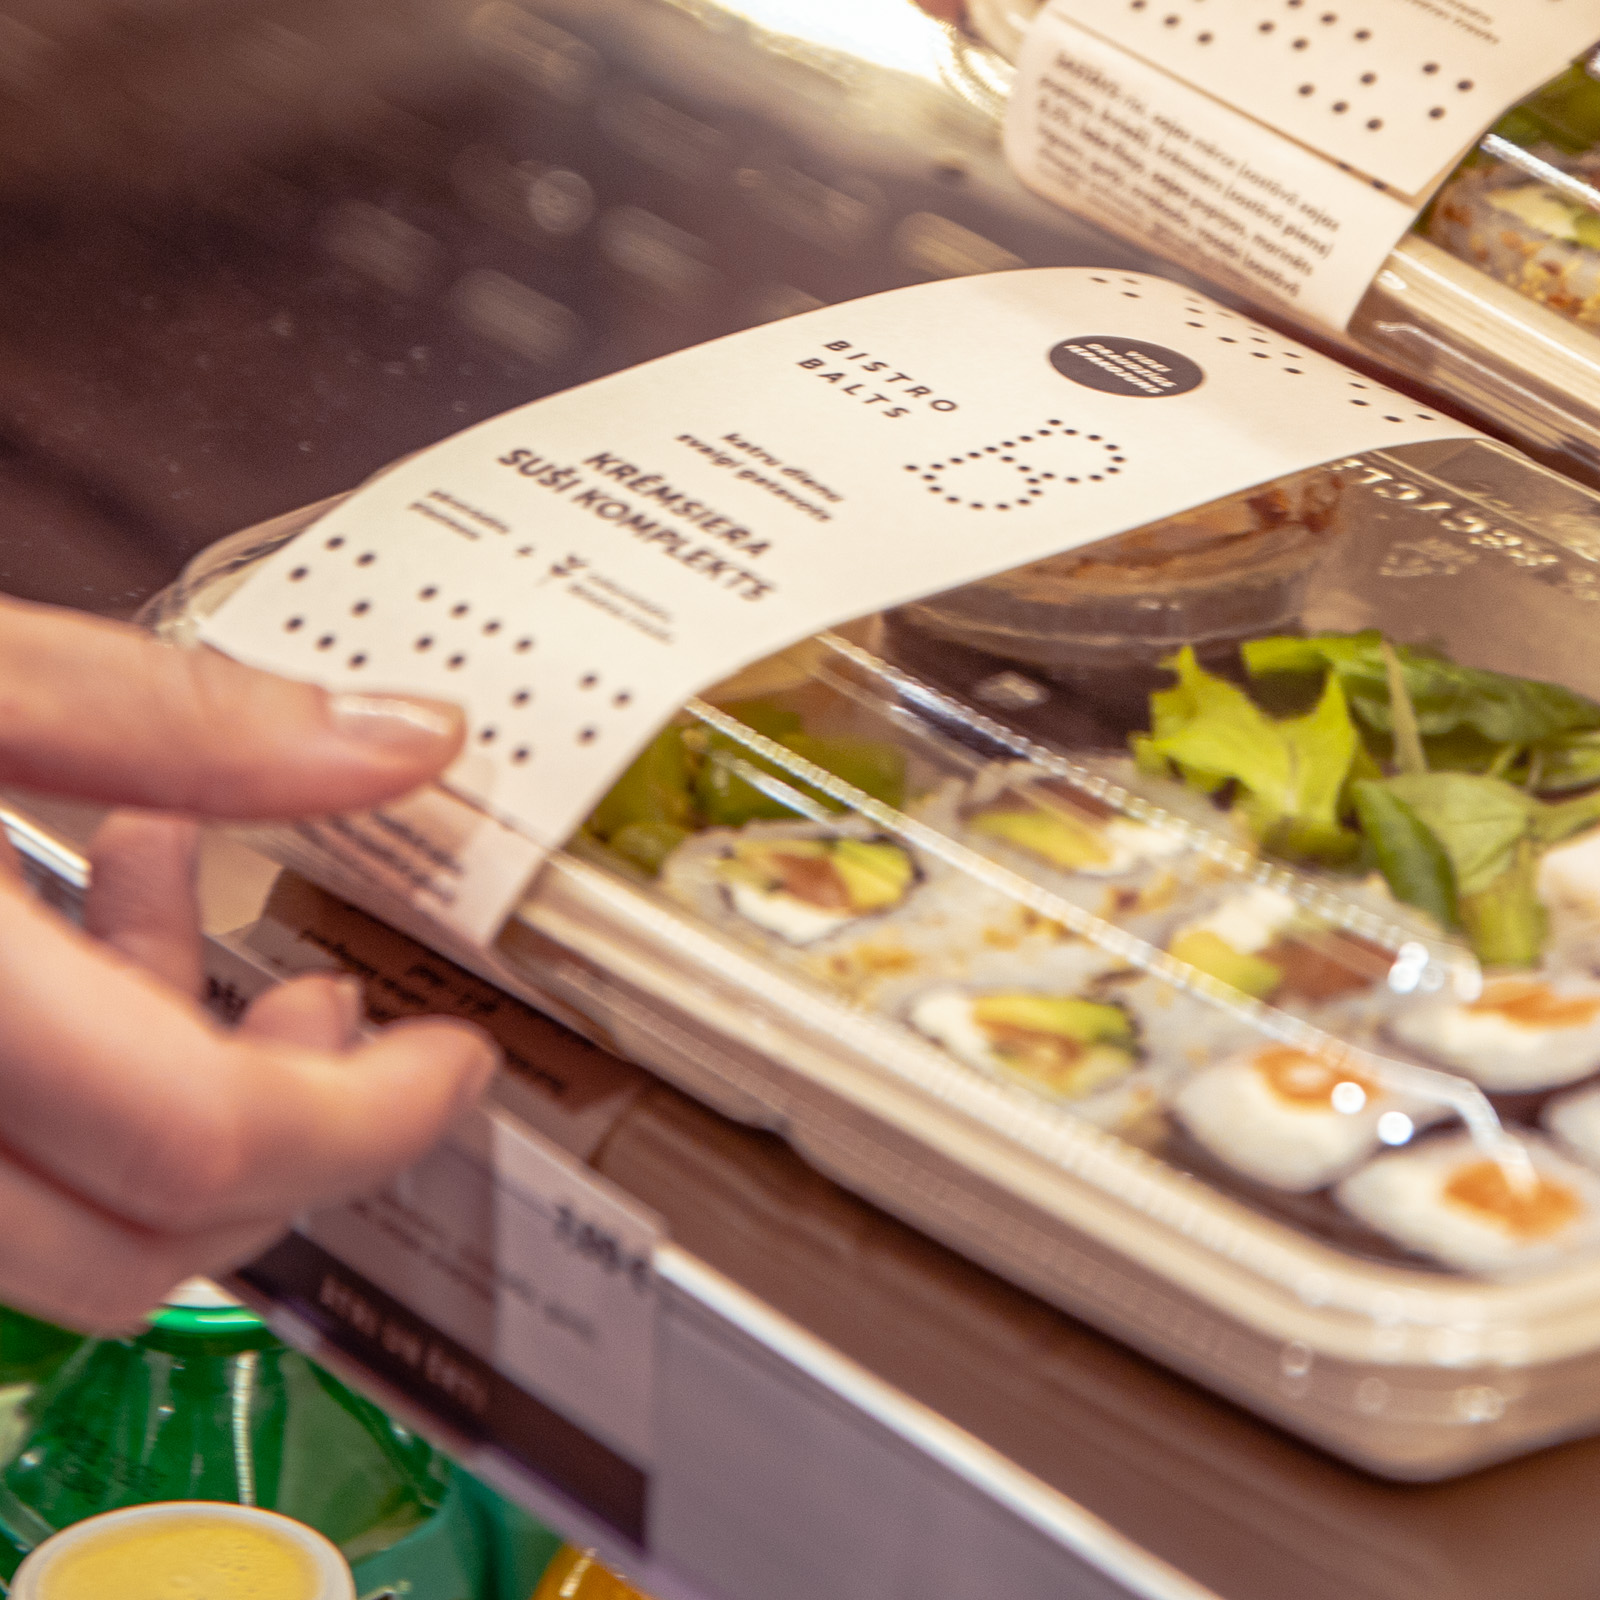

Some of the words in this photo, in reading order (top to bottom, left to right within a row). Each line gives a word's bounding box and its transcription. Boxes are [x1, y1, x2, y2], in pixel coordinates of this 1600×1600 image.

[796, 357, 911, 419] BALTS
[822, 339, 960, 413] BISTRO
[1125, 350, 1172, 373] VIDEI
[720, 432, 783, 468] katru
[495, 446, 583, 495] SUŠI
[570, 486, 777, 603] KOMPLEKTS
[582, 450, 773, 558] KRĒMSIERA
